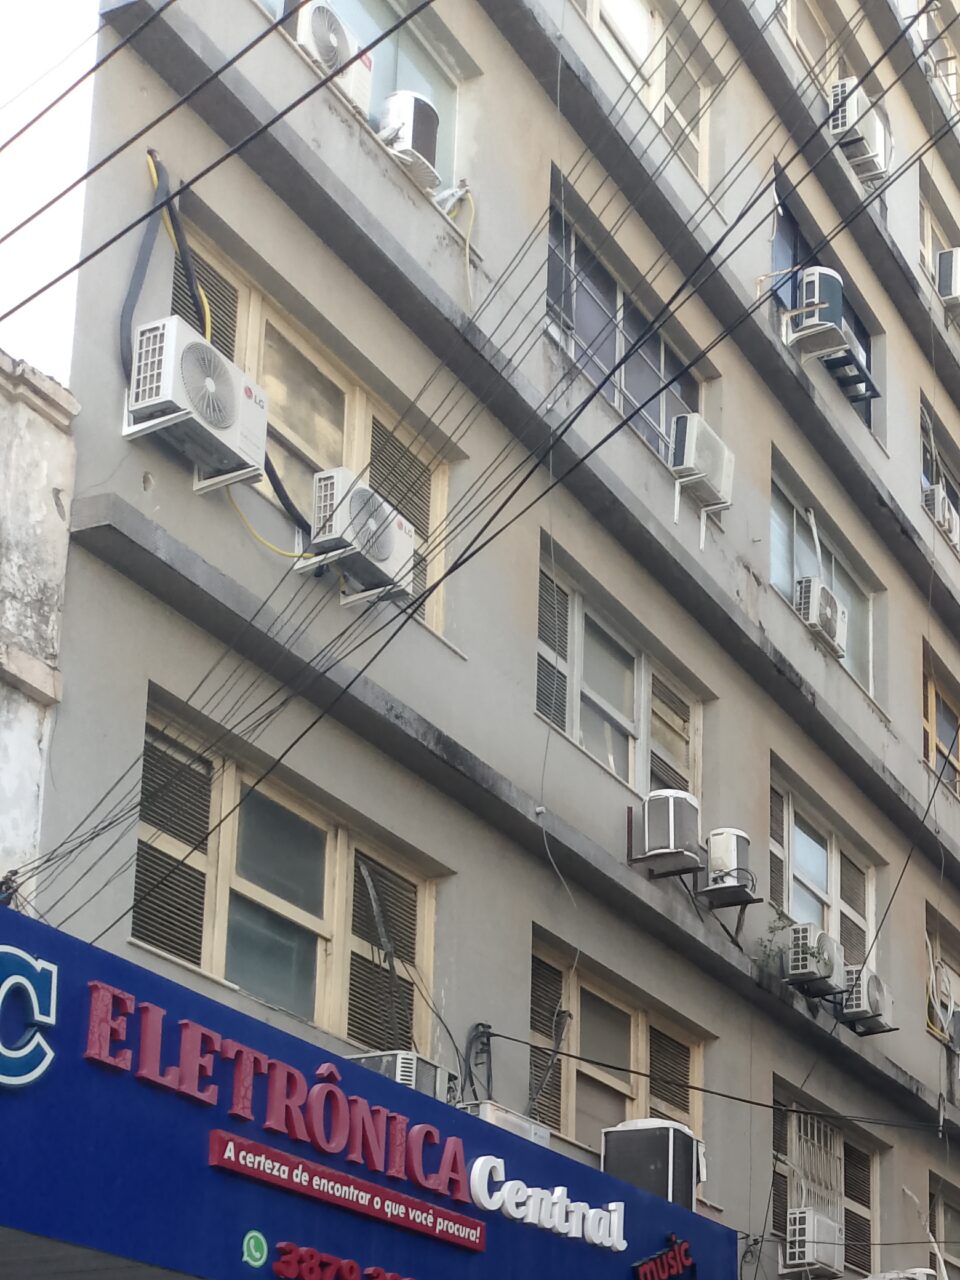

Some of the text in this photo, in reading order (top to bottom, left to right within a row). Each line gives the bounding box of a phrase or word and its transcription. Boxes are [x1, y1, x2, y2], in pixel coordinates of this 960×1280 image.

[254, 395, 265, 410] LG
[83, 980, 628, 1252] ELETRÔNICA Central
[224, 1142, 481, 1244] A certeza de encontrar o que você procura!
